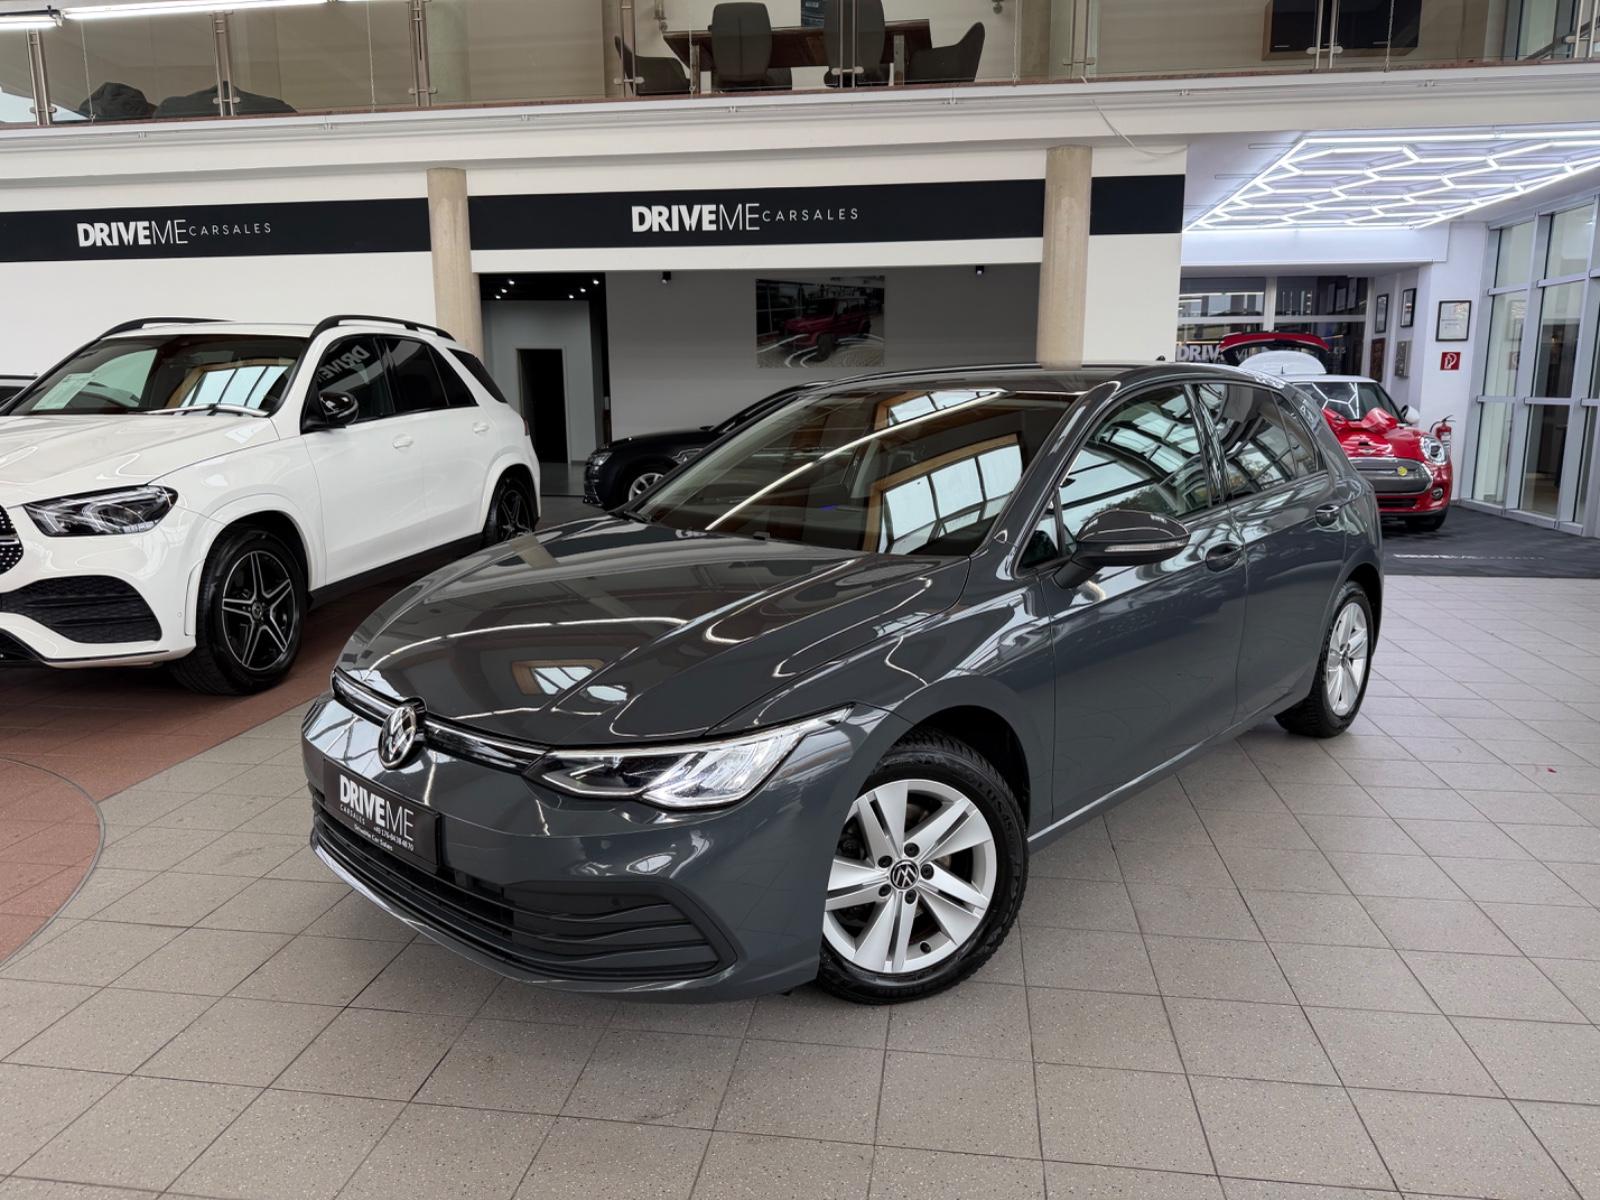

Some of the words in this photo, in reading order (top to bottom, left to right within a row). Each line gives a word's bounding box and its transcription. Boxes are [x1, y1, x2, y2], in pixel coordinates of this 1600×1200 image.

[762, 208, 858, 222] CARSALES
[189, 222, 271, 237] CARSALES
[1176, 345, 1225, 361] DRIV
